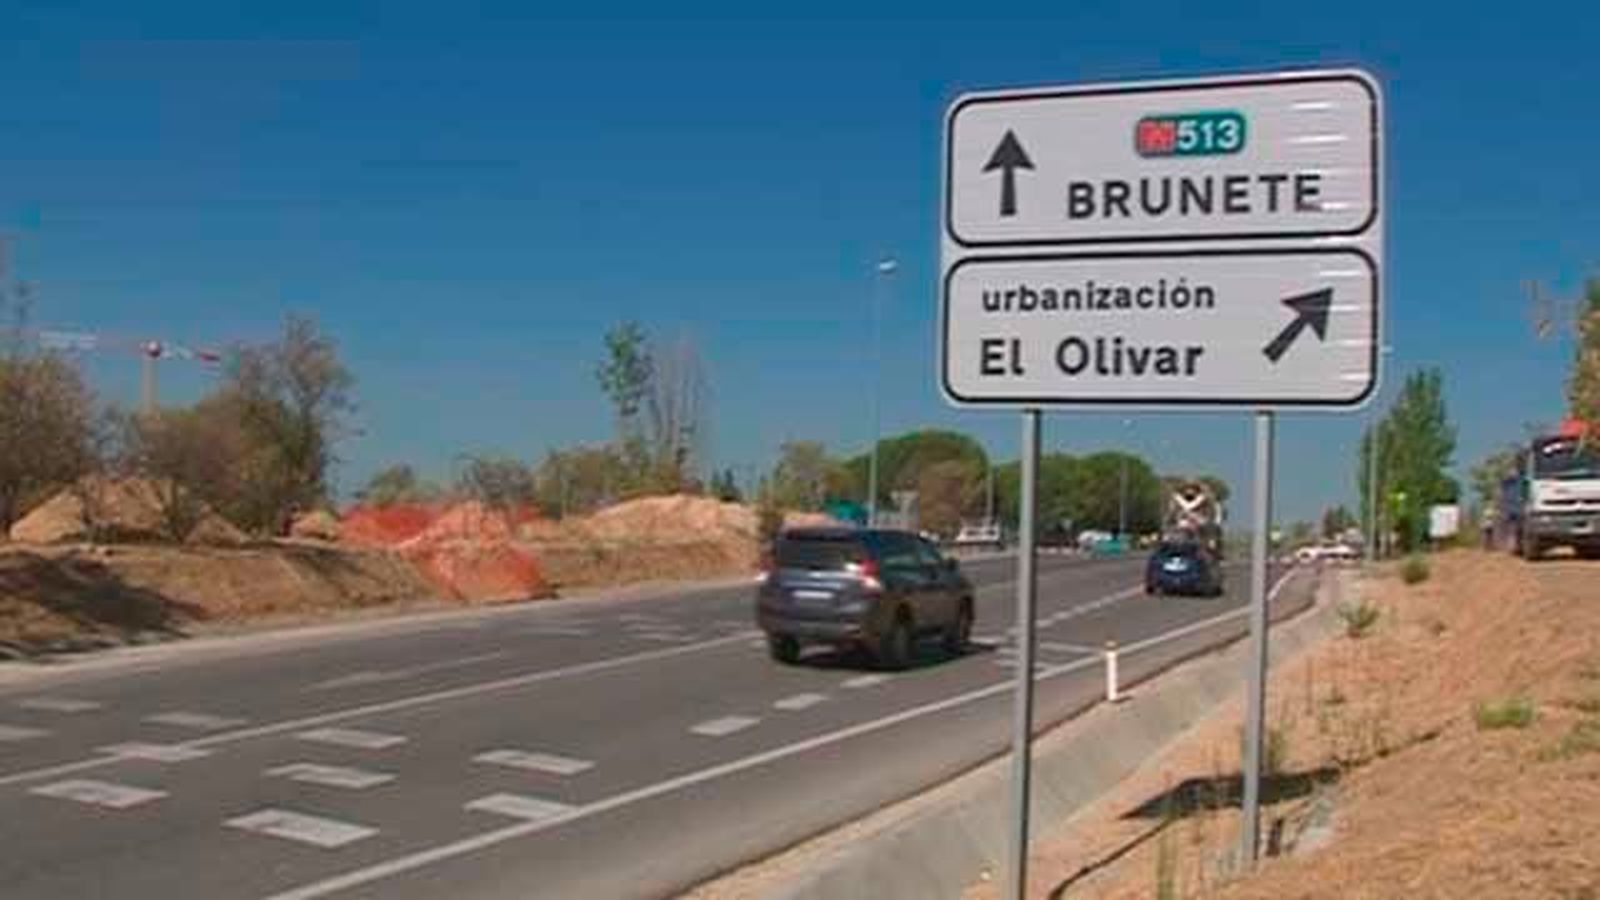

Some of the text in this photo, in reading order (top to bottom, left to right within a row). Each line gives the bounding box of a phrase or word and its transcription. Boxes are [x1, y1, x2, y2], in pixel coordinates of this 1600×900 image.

[1068, 174, 1322, 219] BRUNETE
[982, 277, 1215, 312] urbanización
[980, 336, 1205, 376] El Olivar
